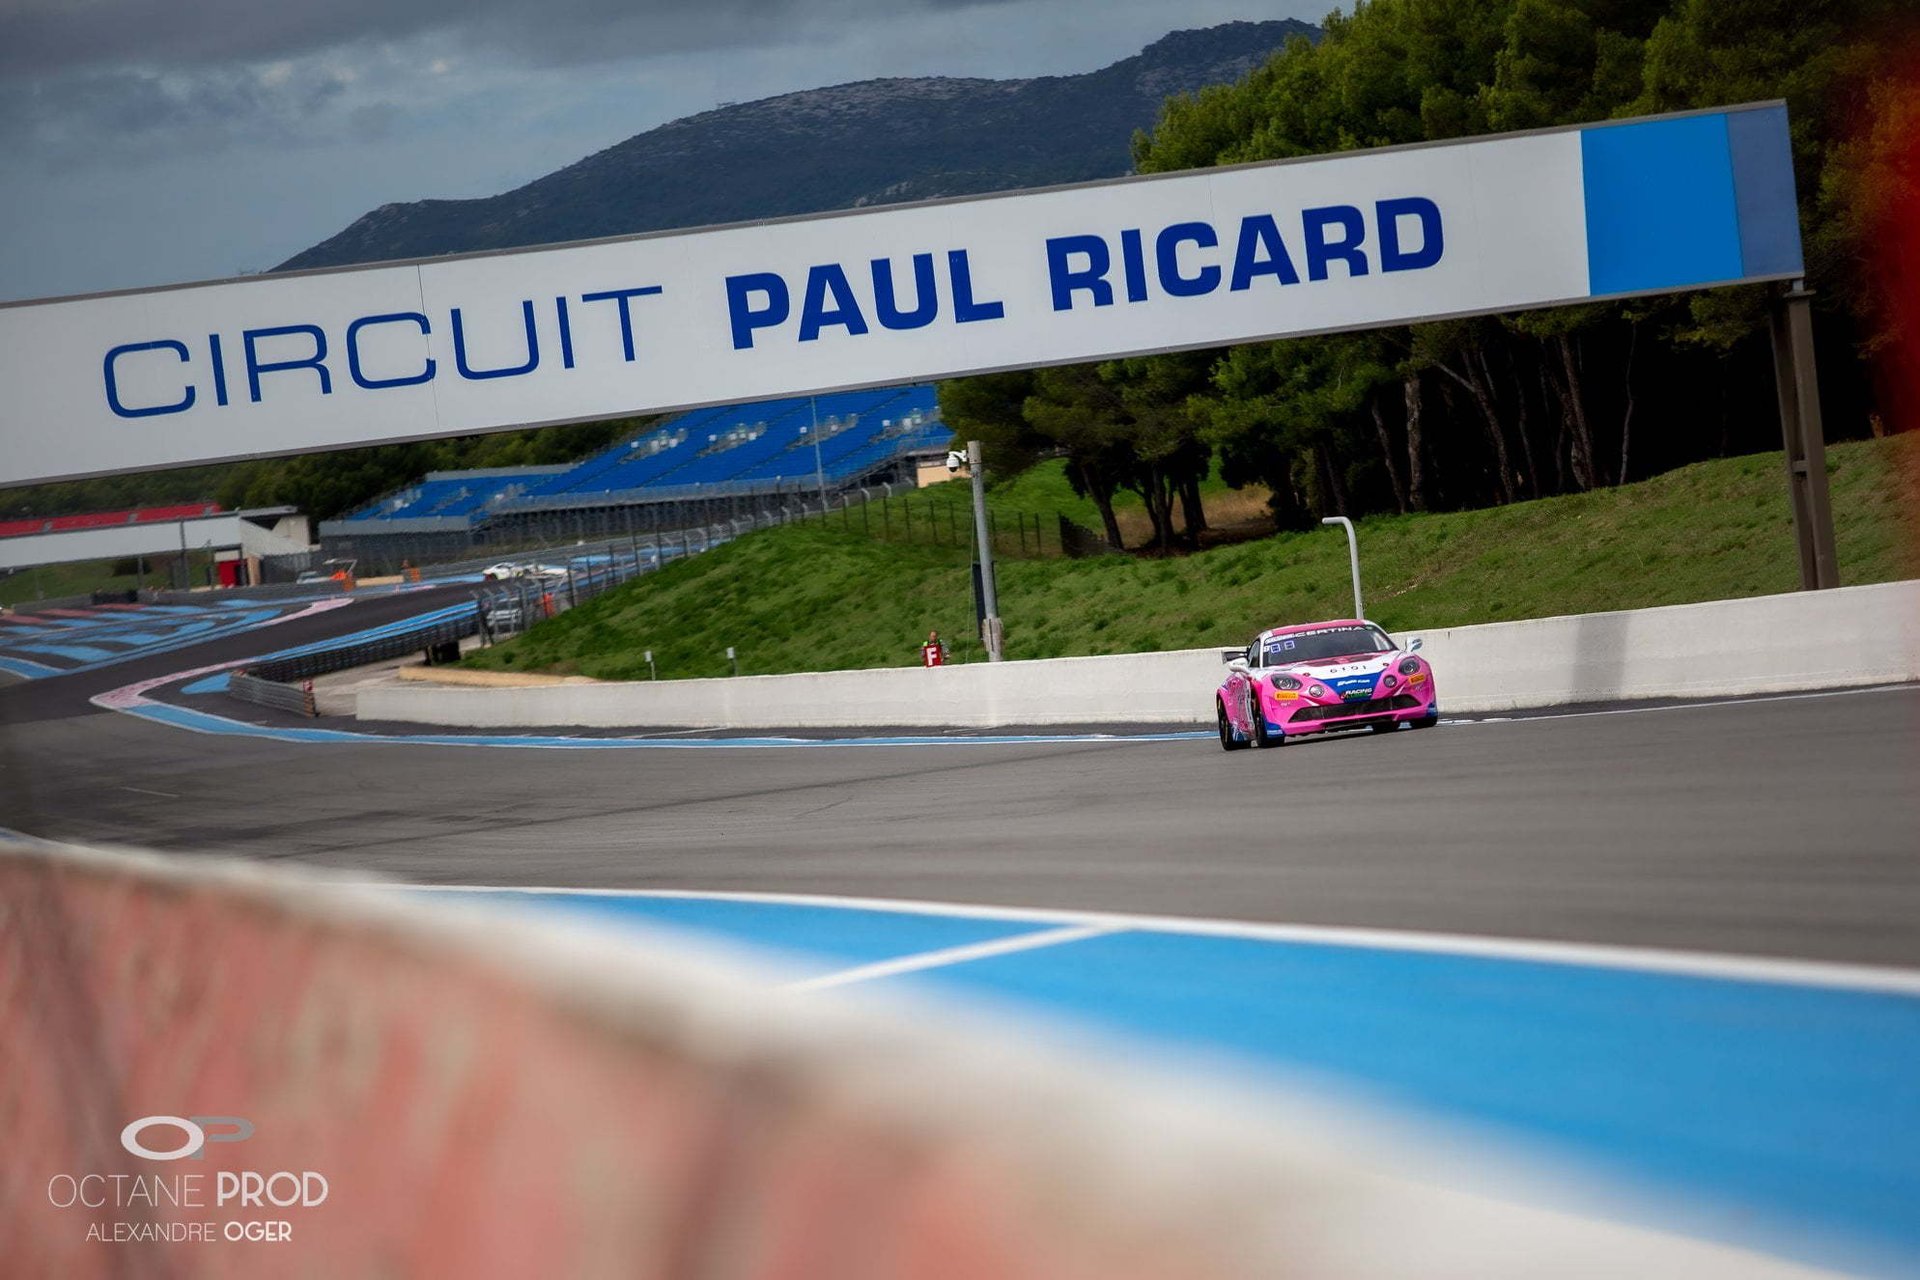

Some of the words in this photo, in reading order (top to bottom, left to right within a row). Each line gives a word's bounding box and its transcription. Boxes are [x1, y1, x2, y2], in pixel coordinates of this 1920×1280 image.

[103, 285, 663, 419] CIRCUIT
[725, 248, 1005, 351] PAUL
[1046, 196, 1445, 312] RICARD
[926, 647, 937, 666] F
